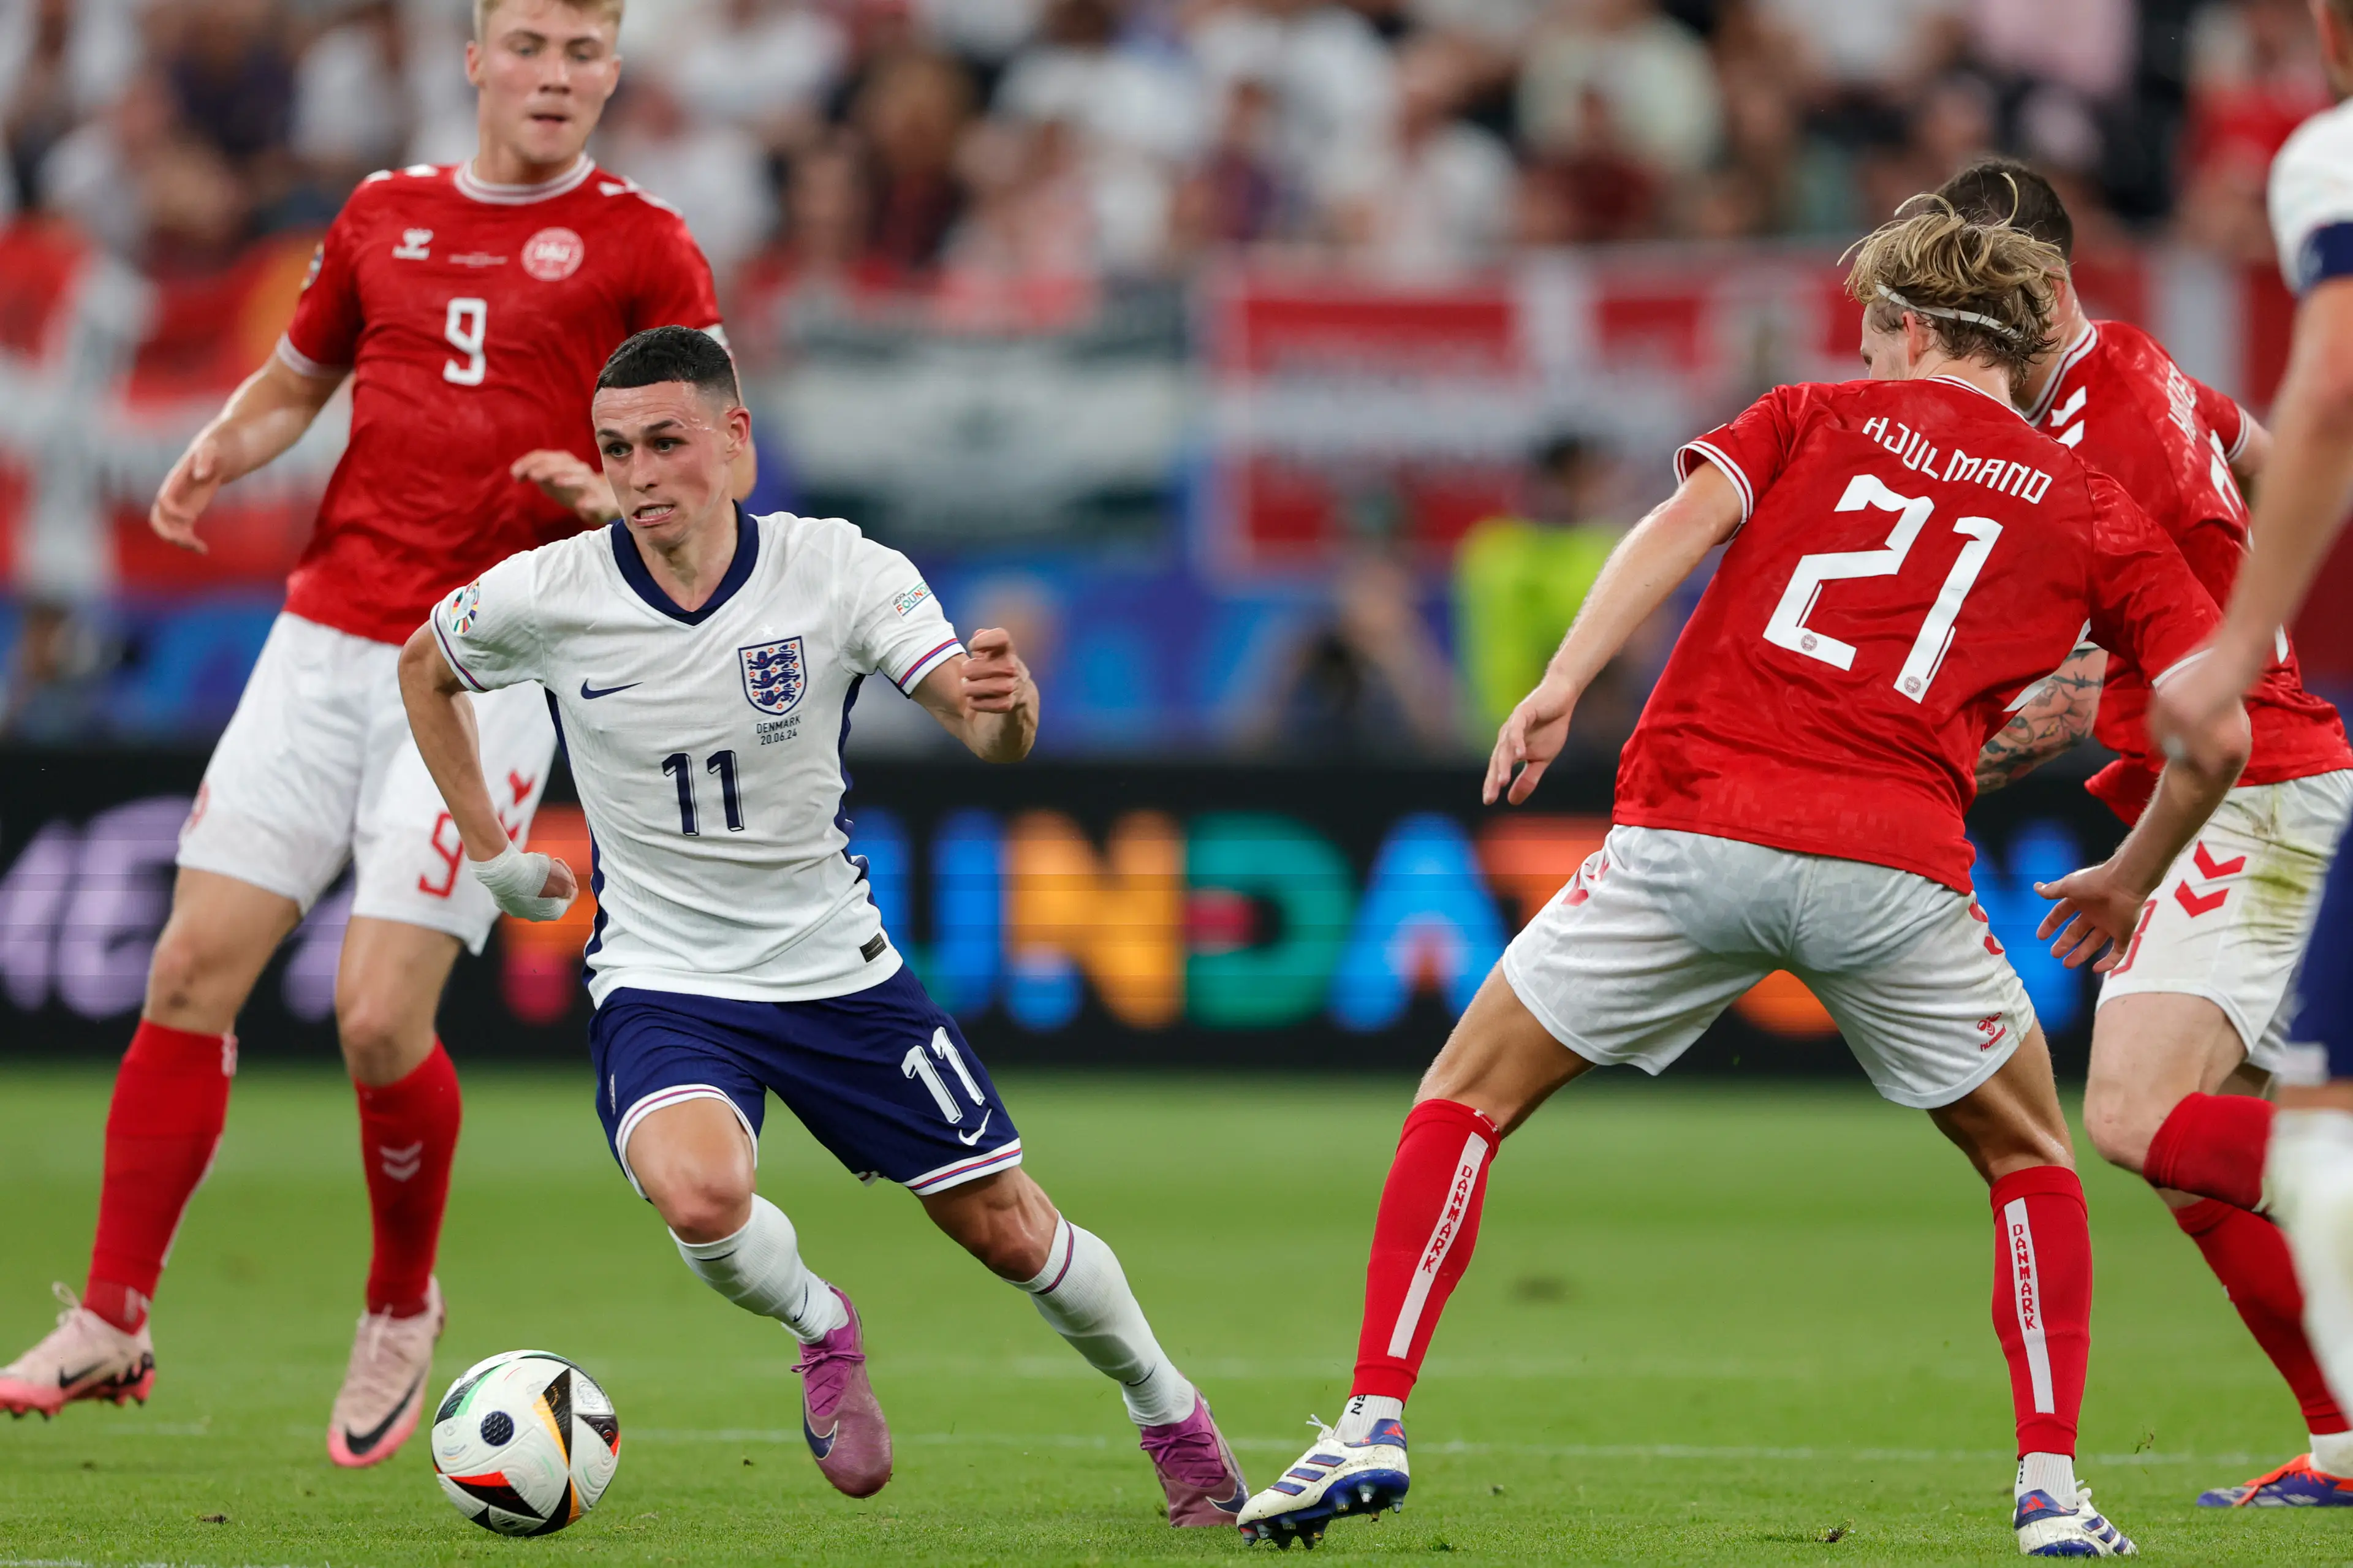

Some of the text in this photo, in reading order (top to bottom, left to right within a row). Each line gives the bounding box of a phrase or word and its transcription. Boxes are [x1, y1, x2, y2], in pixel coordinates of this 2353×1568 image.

[443, 297, 487, 386] 9
[1862, 417, 2052, 504] HJULMAND
[896, 584, 929, 614] FOUND
[1762, 474, 2004, 704] 21
[757, 714, 800, 733] DENMARK
[760, 728, 797, 745] 20.06.24
[662, 749, 744, 836] 11
[901, 1026, 986, 1124] 11
[1422, 1165, 1472, 1273] DANMARK
[2013, 1224, 2037, 1330] DANMARK
